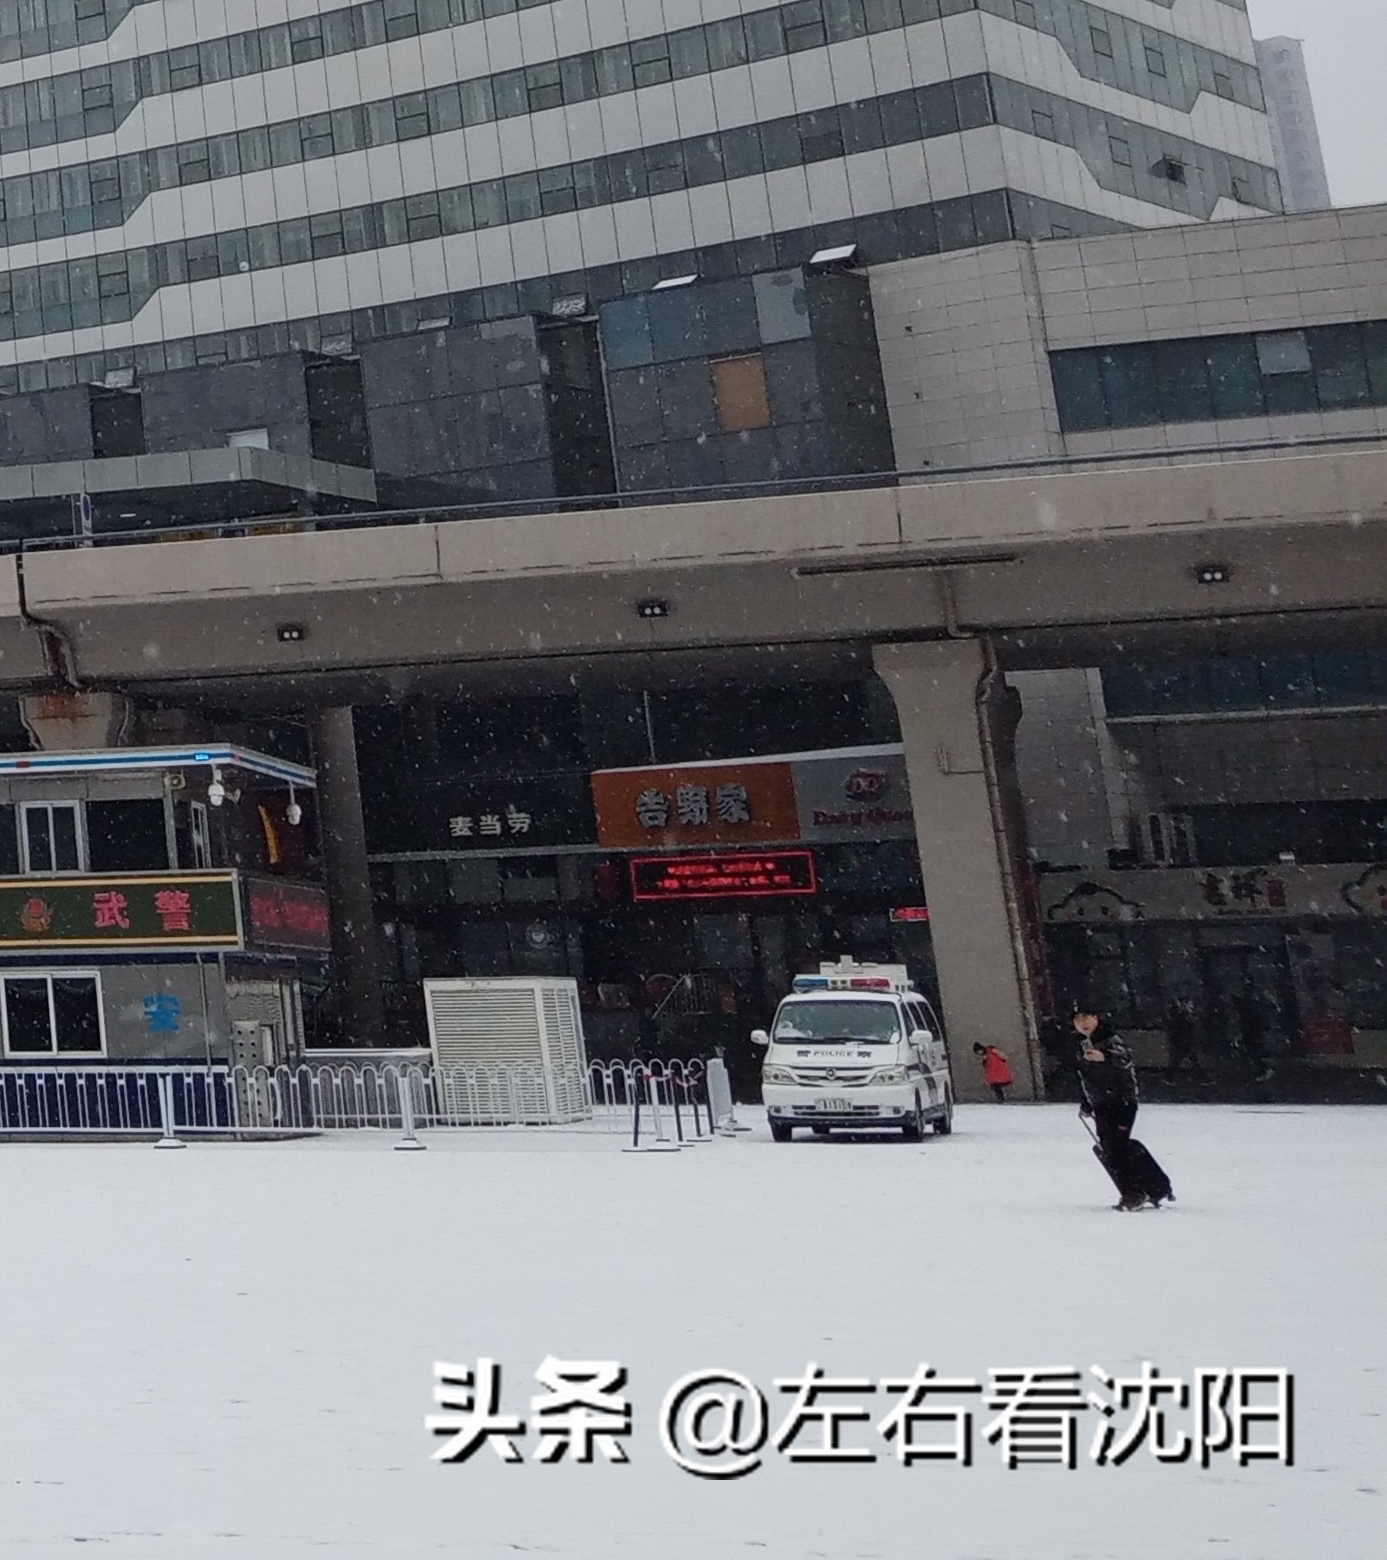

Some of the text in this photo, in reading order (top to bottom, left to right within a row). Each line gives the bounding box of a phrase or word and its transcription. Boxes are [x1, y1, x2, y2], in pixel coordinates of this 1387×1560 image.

[448, 812, 532, 837] 麦当劳
[634, 782, 752, 829] 吉野家
[93, 889, 192, 932] 武警
